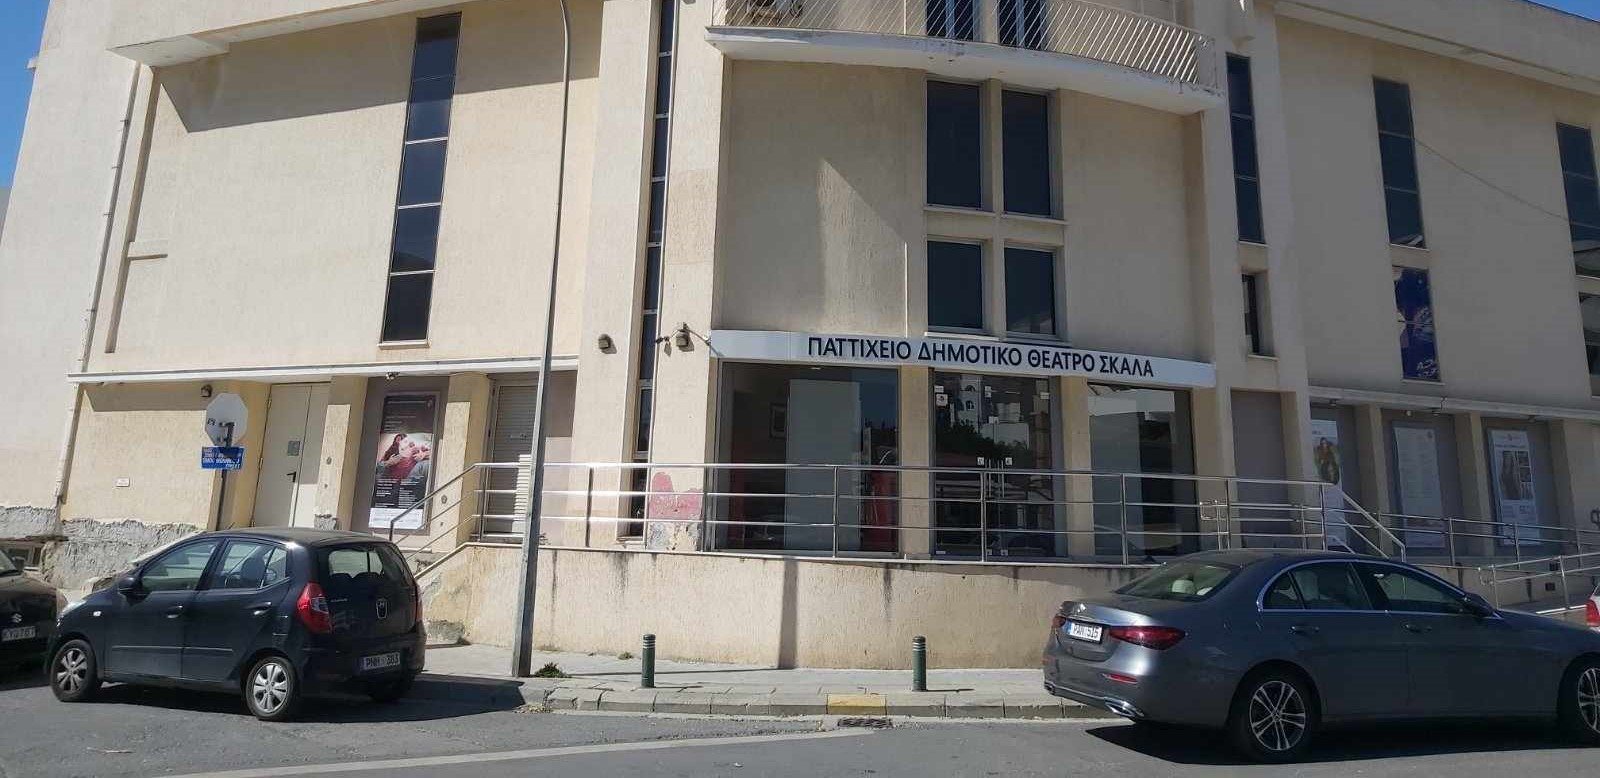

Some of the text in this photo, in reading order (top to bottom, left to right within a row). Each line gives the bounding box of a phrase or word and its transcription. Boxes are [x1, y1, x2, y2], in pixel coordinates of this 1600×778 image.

[808, 337, 1154, 377] ΠΑΤΤΙΧΕΙΟ ΔΗΜΟΤΙΚΟ ΘΕΑΤΡΟ ΣΚΑΛΑ
